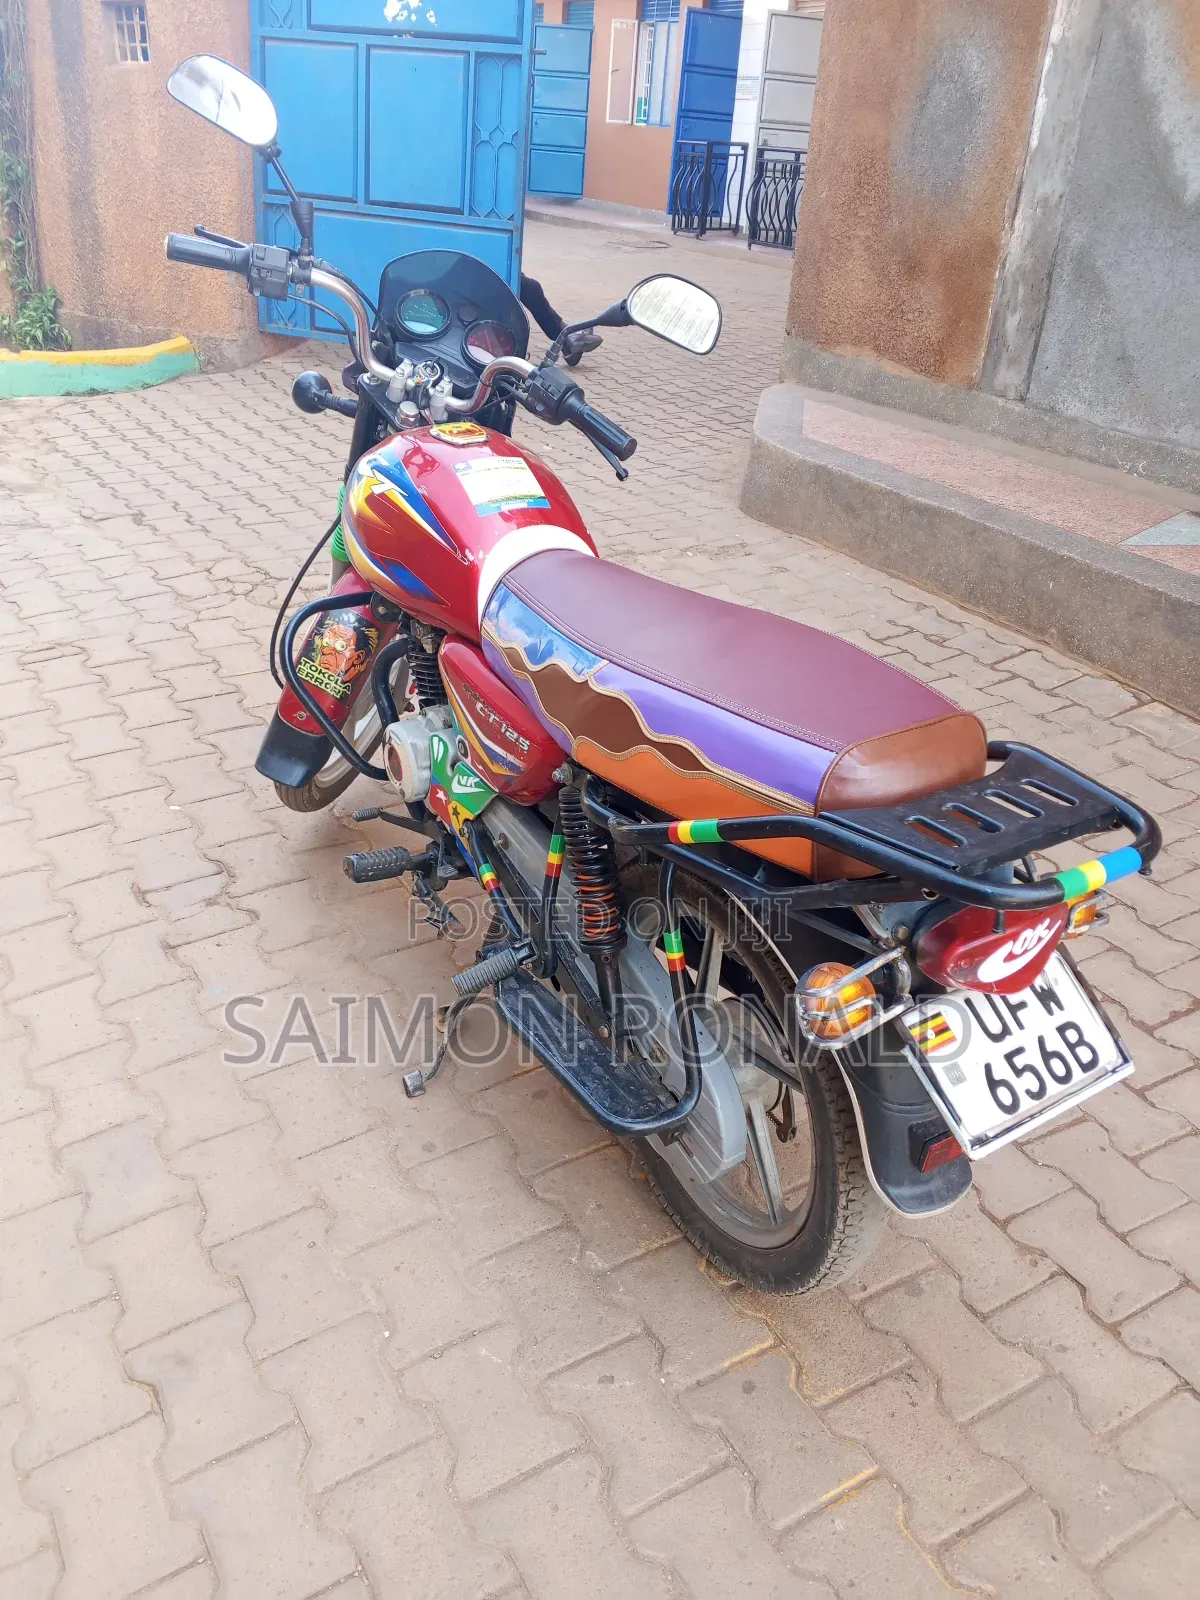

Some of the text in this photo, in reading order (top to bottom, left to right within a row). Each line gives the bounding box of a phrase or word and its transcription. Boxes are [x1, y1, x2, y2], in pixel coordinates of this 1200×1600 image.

[296, 665, 342, 699] ERROR
[301, 658, 351, 695] TOKOLA
[984, 1020, 1100, 1116] 656B
